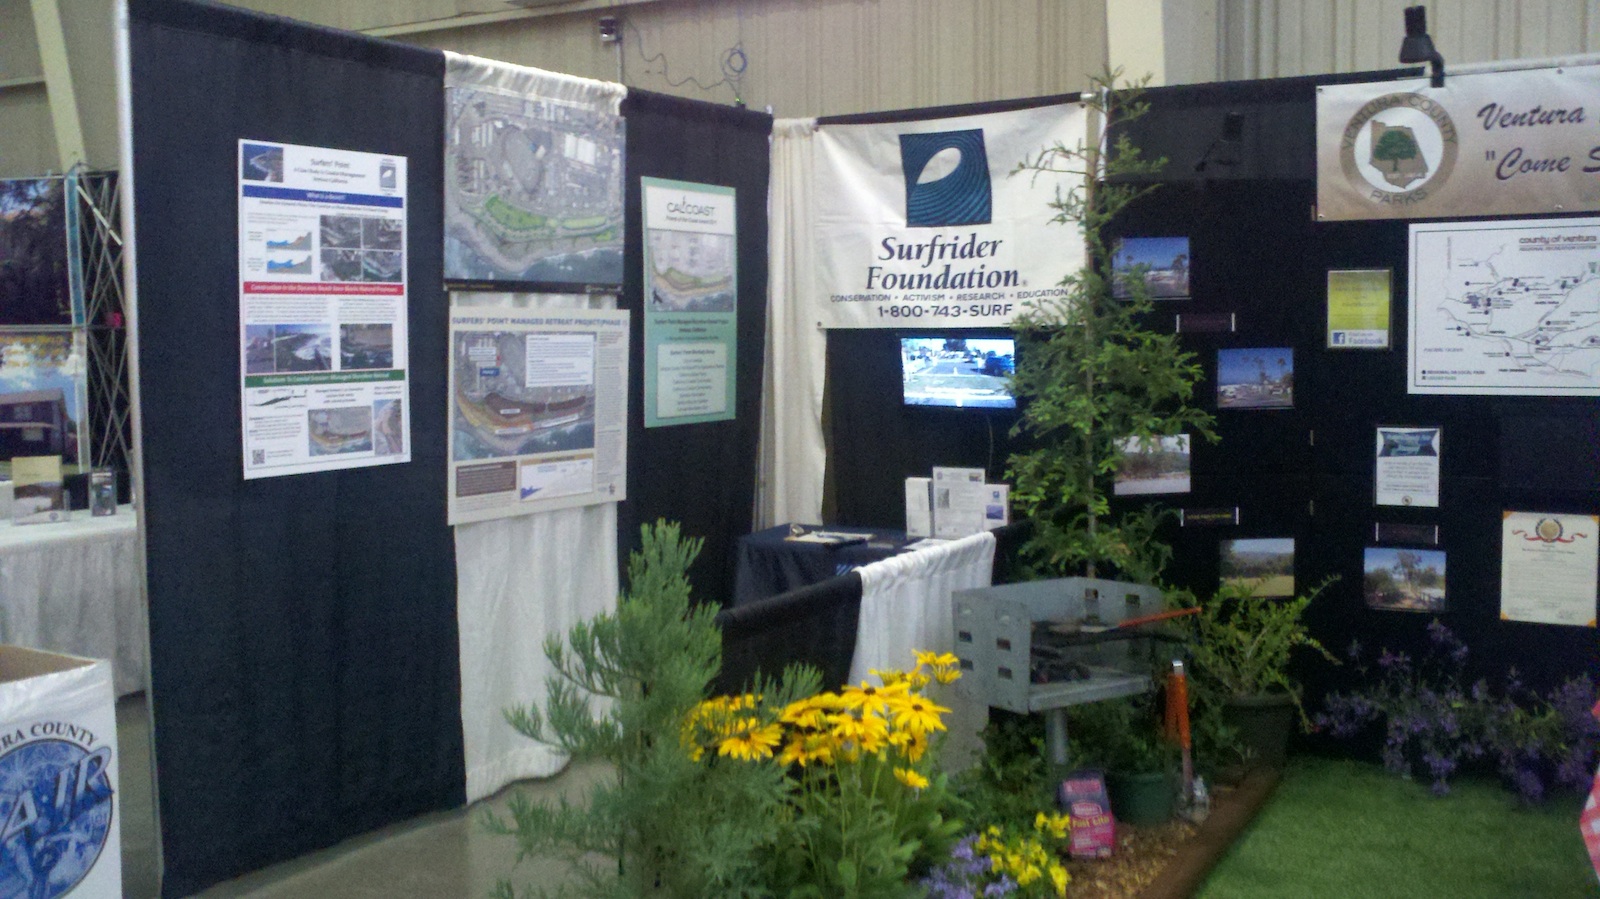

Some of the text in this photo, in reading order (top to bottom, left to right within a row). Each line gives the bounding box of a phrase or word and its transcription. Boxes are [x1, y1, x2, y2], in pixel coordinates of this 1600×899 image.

[1408, 94, 1458, 144] COUNTY
[1476, 102, 1586, 131] Ventura
[1370, 188, 1428, 206] PARKS
[877, 232, 1004, 268] Surfrider
[866, 264, 1020, 291] Foundation
[830, 289, 1069, 303] CONSERVATION ACTIVISM RESEARCH EDUCATION
[487, 317, 508, 325] POINT
[510, 318, 544, 326] MANAGED
[545, 318, 574, 326] RETREAT
[877, 303, 1013, 318] 1-800-743-SURF
[30, 722, 96, 746] COUNTY
